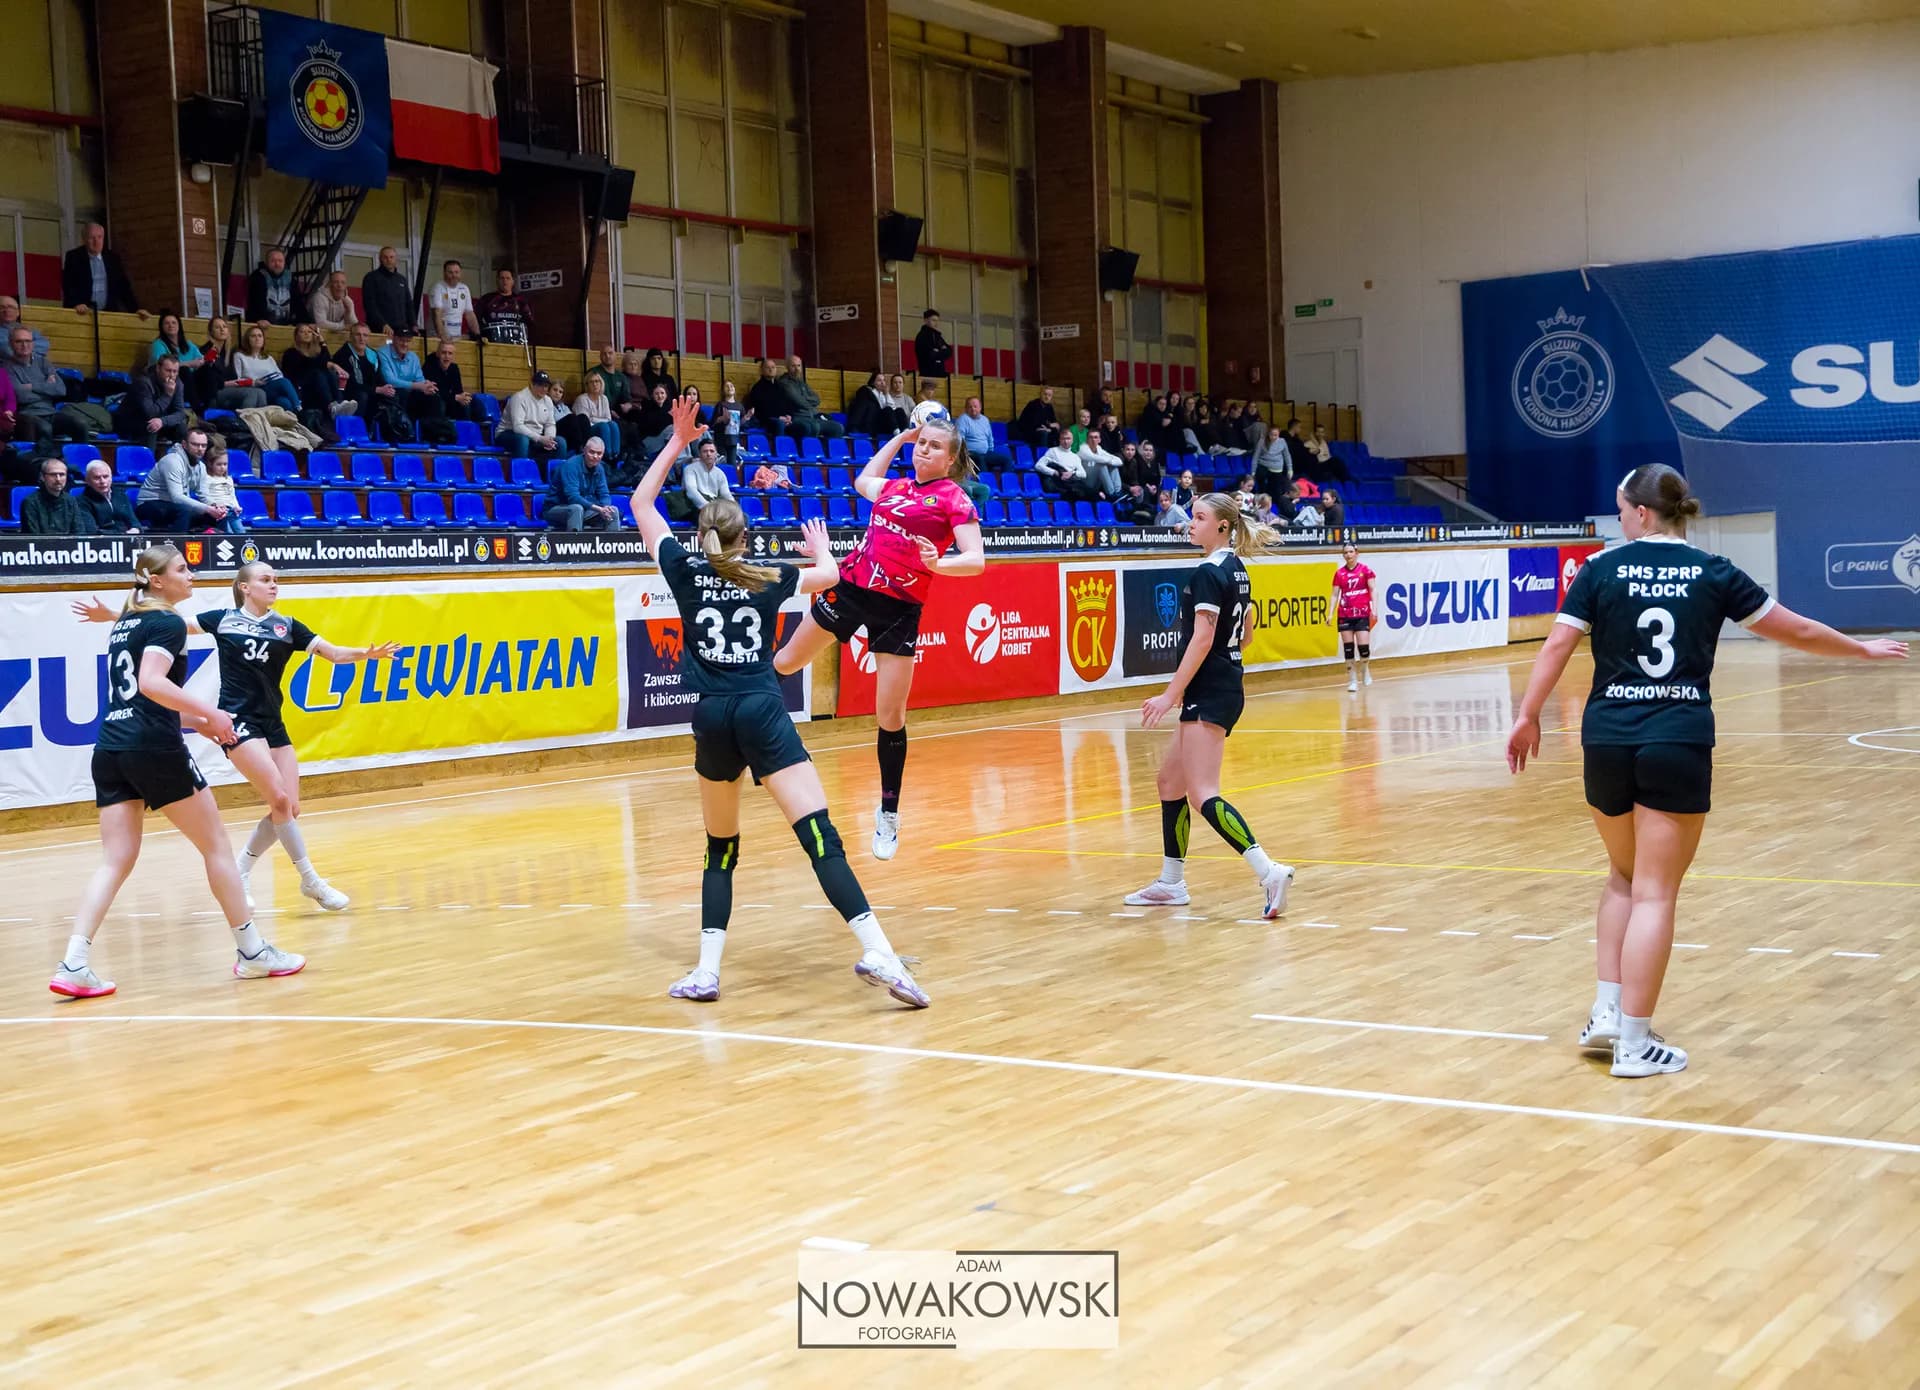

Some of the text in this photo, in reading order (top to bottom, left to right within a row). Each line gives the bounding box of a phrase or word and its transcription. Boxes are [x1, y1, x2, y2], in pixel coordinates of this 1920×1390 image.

[310, 65, 340, 80] SUZUKI
[1542, 339, 1582, 354] SUZUKI
[1523, 389, 1605, 429] KORONA HANDBALL
[265, 538, 469, 563] www.koronahandball.pl
[1617, 565, 1703, 580] SMS ZPRP
[694, 575, 723, 588] SMS
[1347, 578, 1360, 589] 17
[702, 589, 750, 602] PŁOCK
[1628, 582, 1688, 597] PŁOCK
[1385, 578, 1499, 629] SUZUKI
[1001, 611, 1020, 624] LIGA
[695, 606, 763, 654] 33
[1001, 625, 1050, 640] CENTRALNA
[1072, 615, 1107, 668] CK
[1637, 607, 1675, 678] 3
[243, 638, 270, 662] 34
[1001, 642, 1032, 657] KOBIET
[359, 633, 599, 704] LEWIATAN
[1605, 683, 1700, 700] ŻOCHOWSKA
[644, 694, 648, 707] i
[105, 707, 134, 721] JUREK
